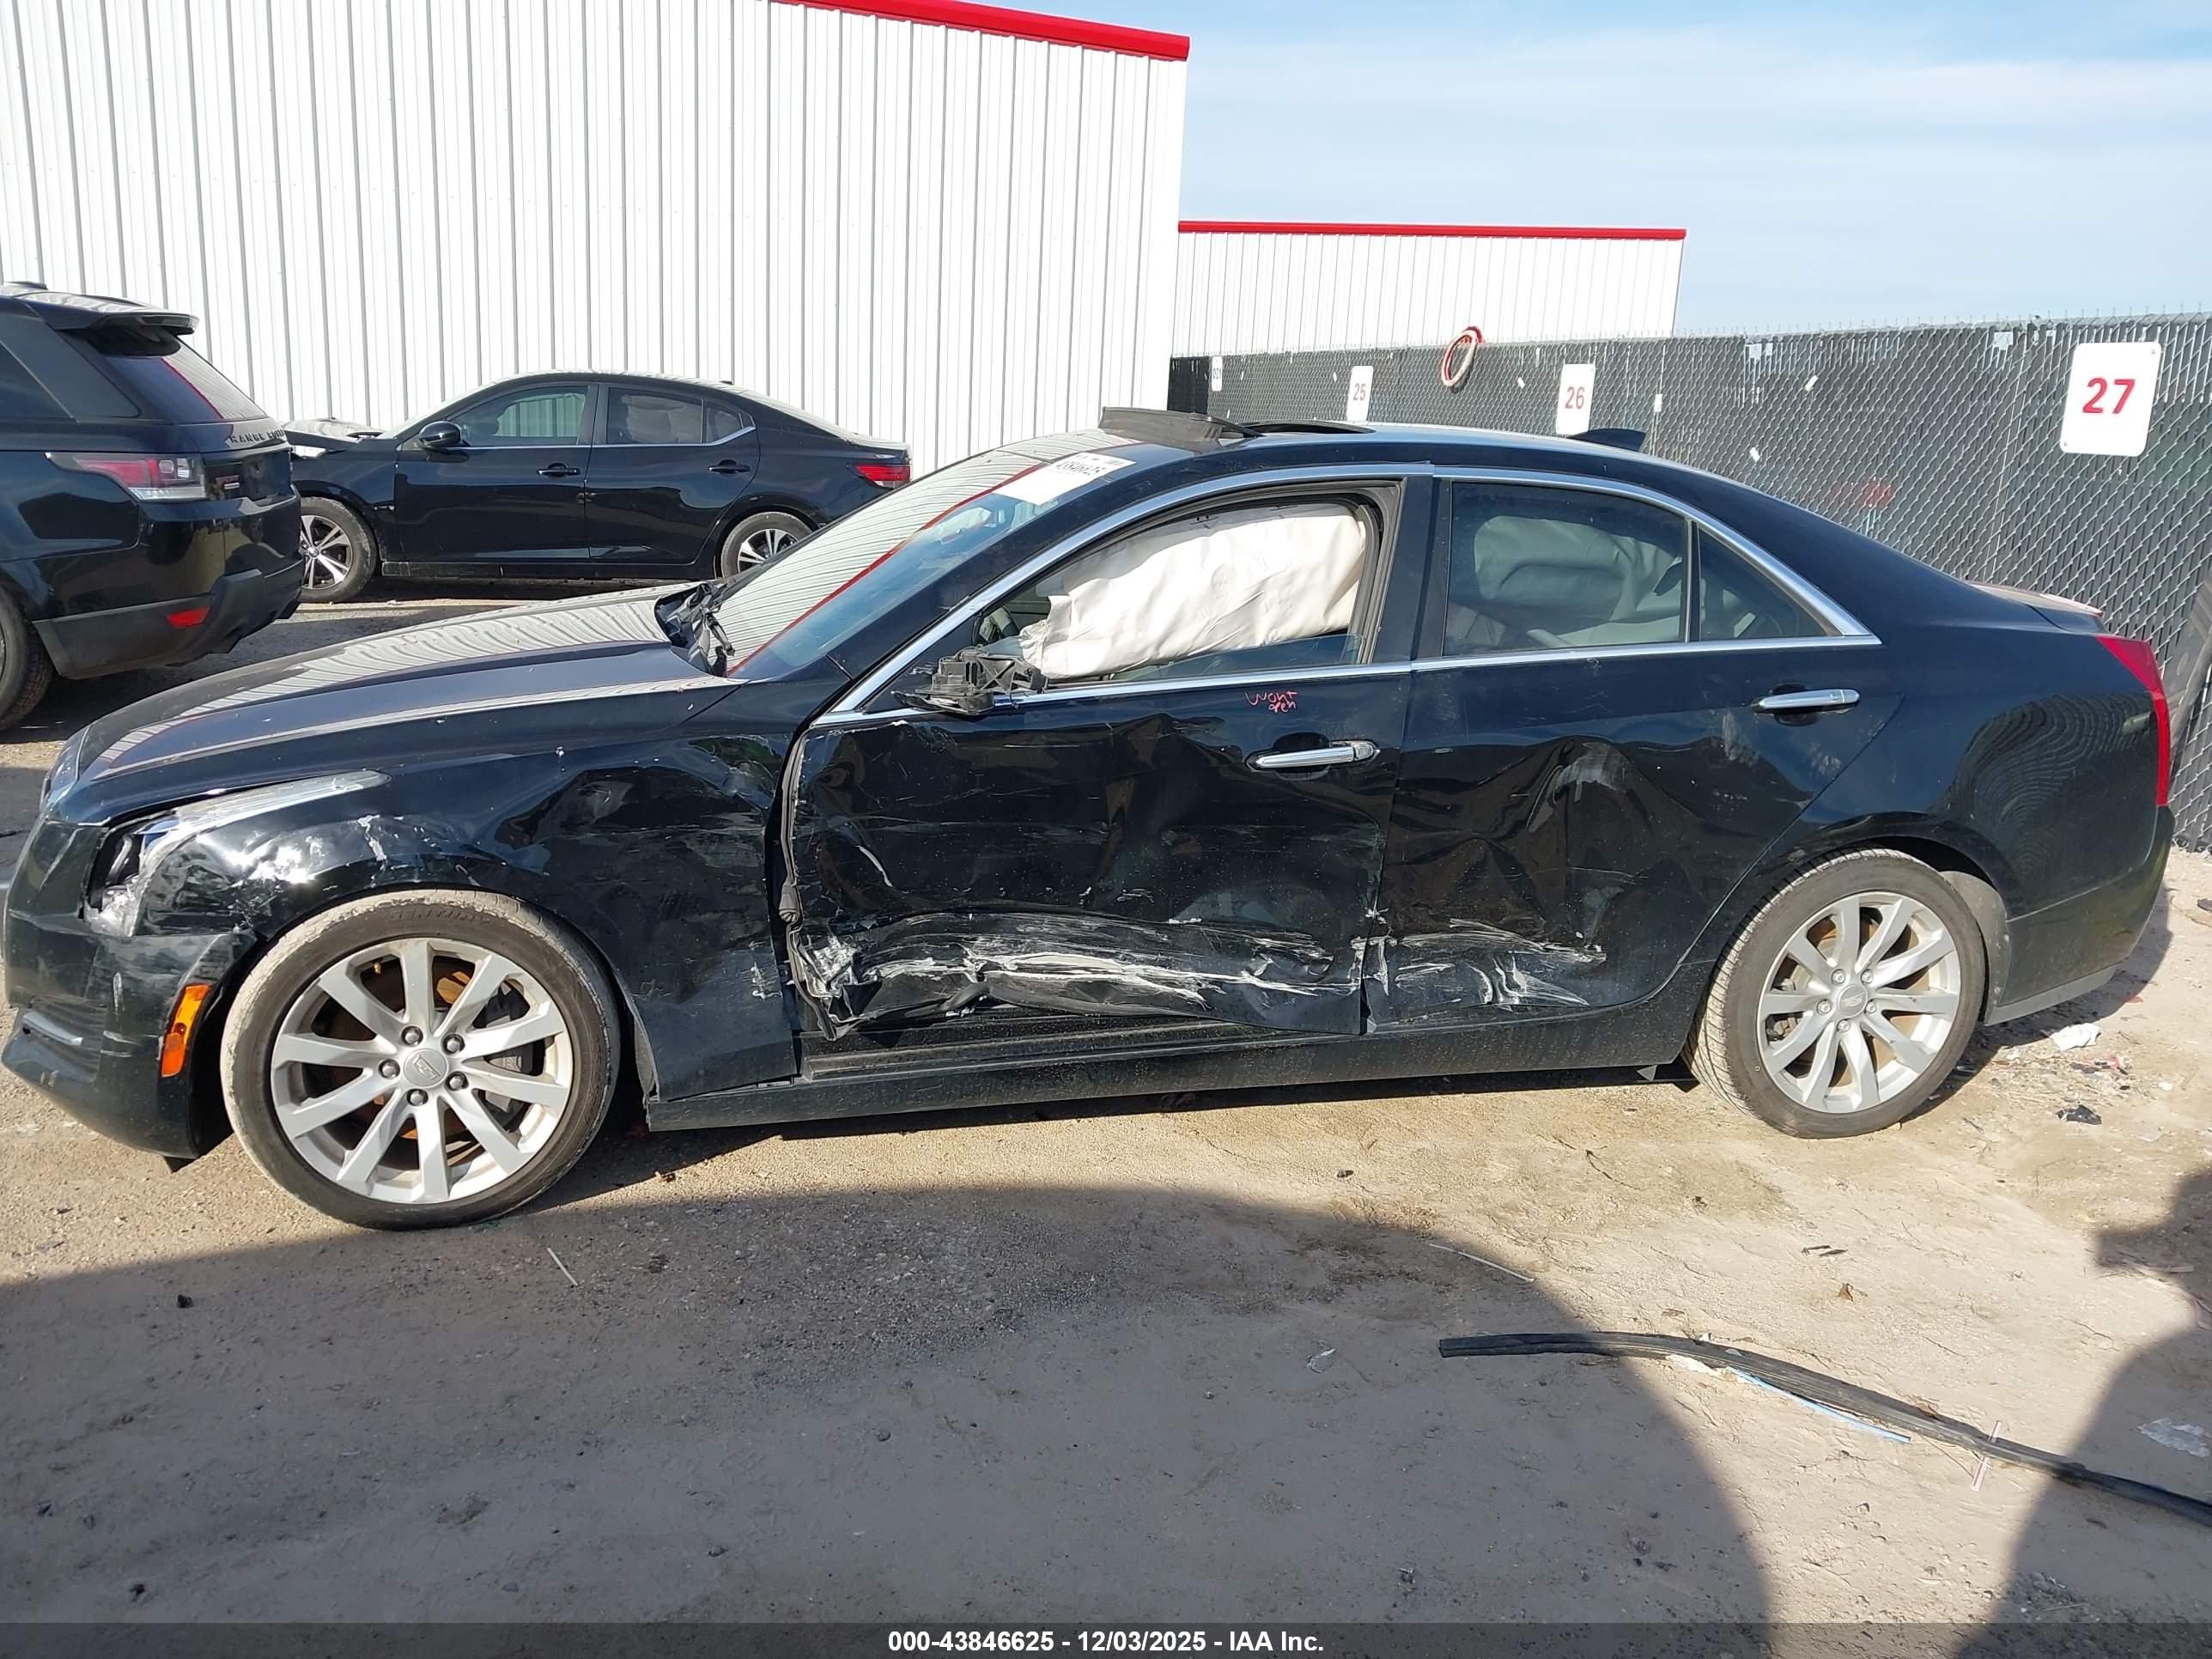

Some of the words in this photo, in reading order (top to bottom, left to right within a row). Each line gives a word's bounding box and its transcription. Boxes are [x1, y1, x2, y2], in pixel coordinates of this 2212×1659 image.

[1352, 383, 1366, 401] 25
[1565, 386, 1585, 410] 26
[2081, 377, 2136, 414] 27
